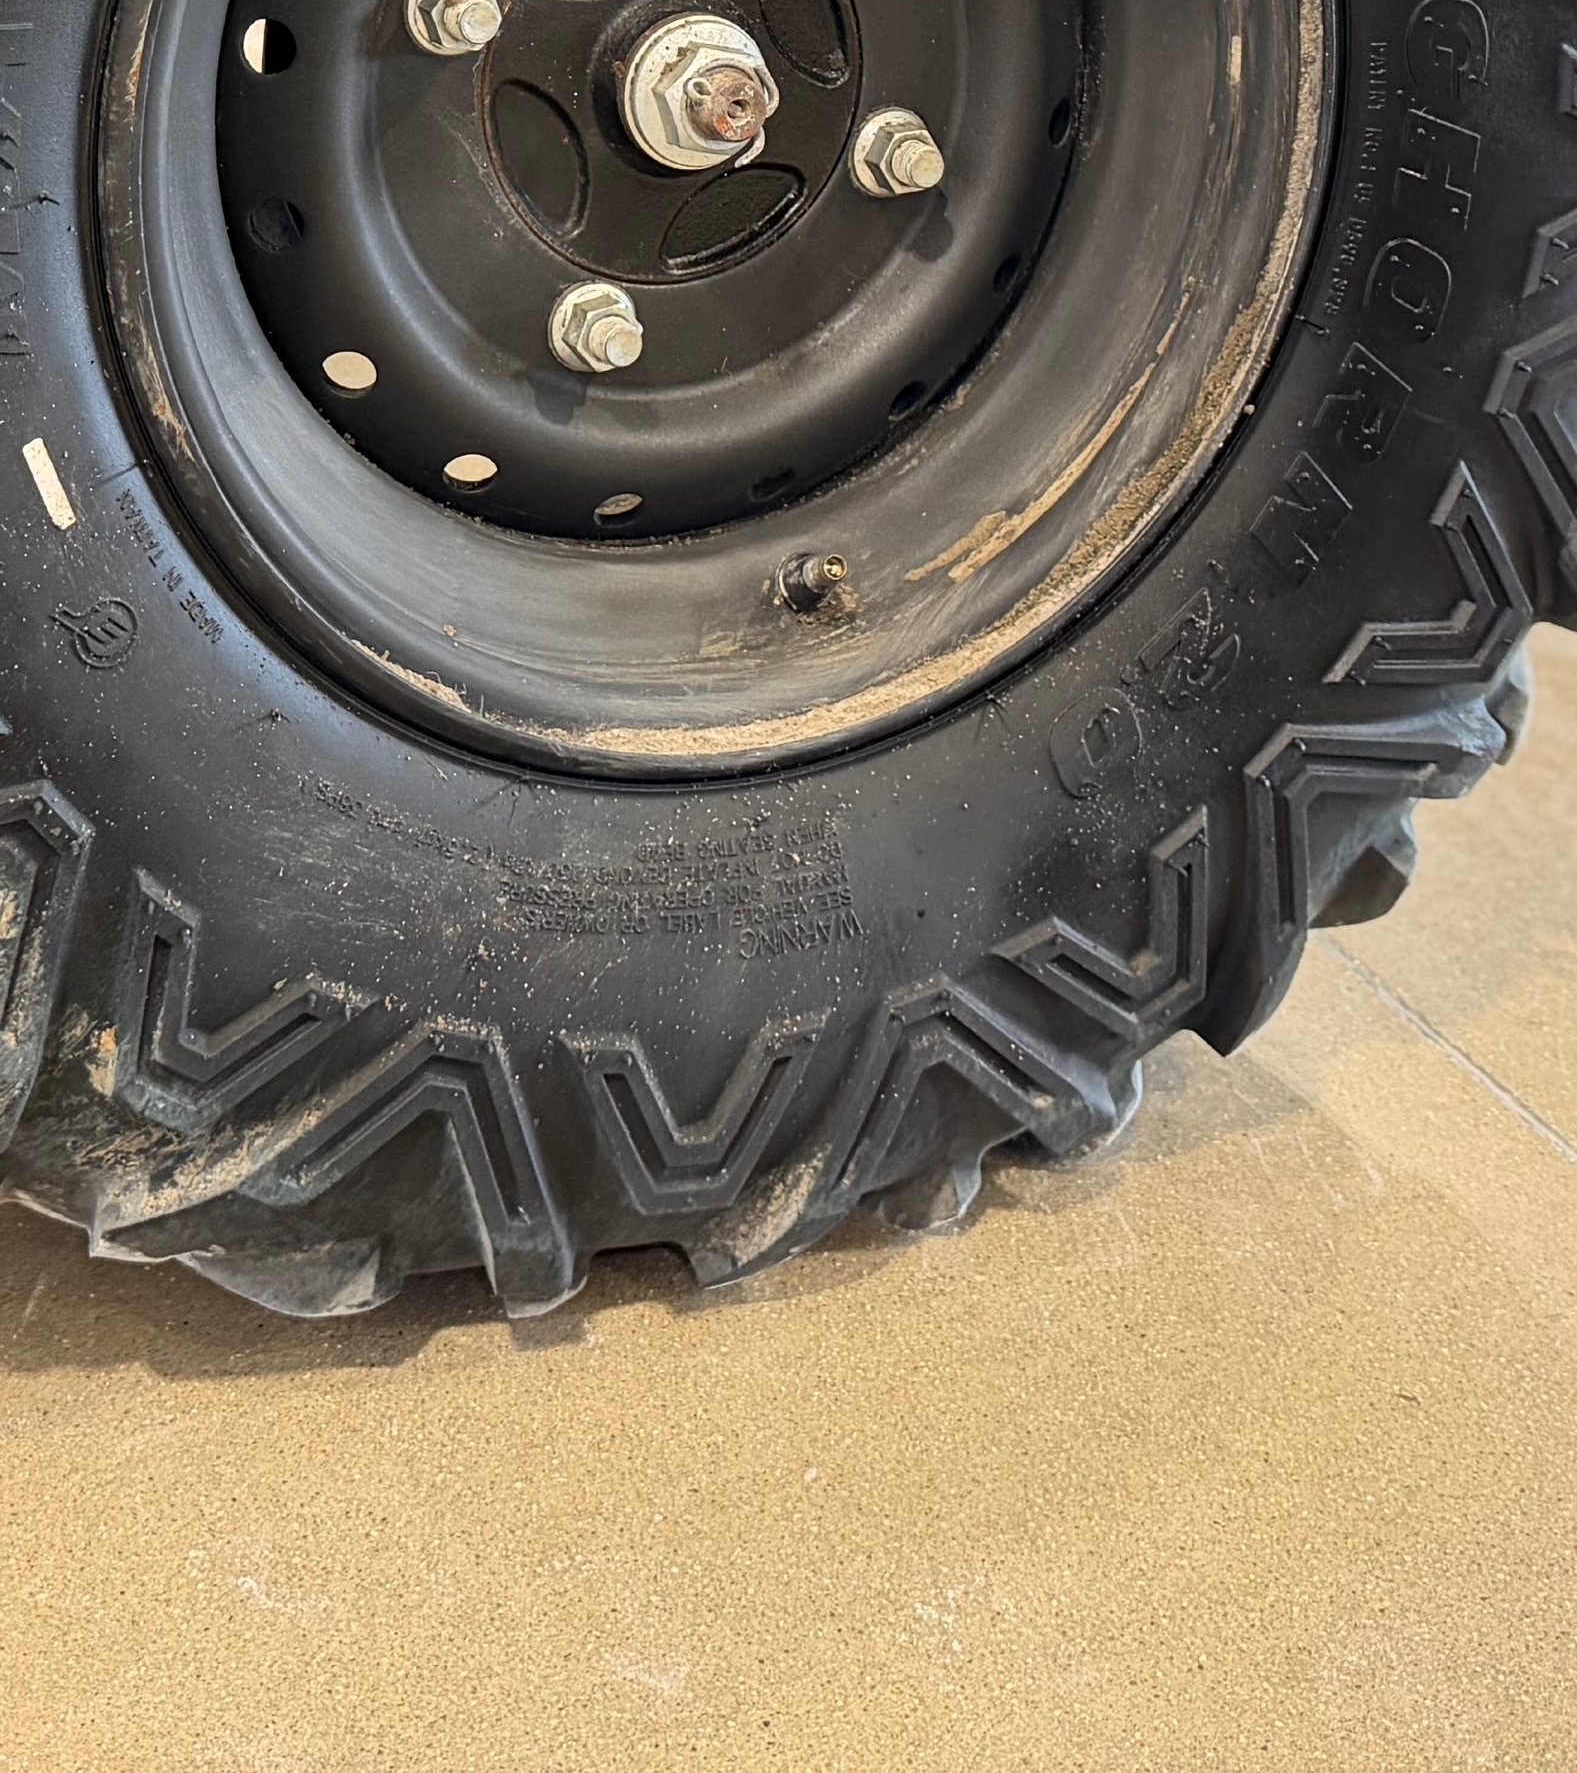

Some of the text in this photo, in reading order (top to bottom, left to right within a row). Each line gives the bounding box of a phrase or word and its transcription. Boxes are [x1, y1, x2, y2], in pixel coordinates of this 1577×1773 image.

[162, 565, 184, 592] IN
[179, 589, 224, 644] MADE
[725, 885, 762, 906] FOR
[819, 887, 853, 911] SEE
[660, 911, 721, 933] LABEL
[729, 899, 808, 928] VEHICLE
[739, 909, 864, 960] WARNING
